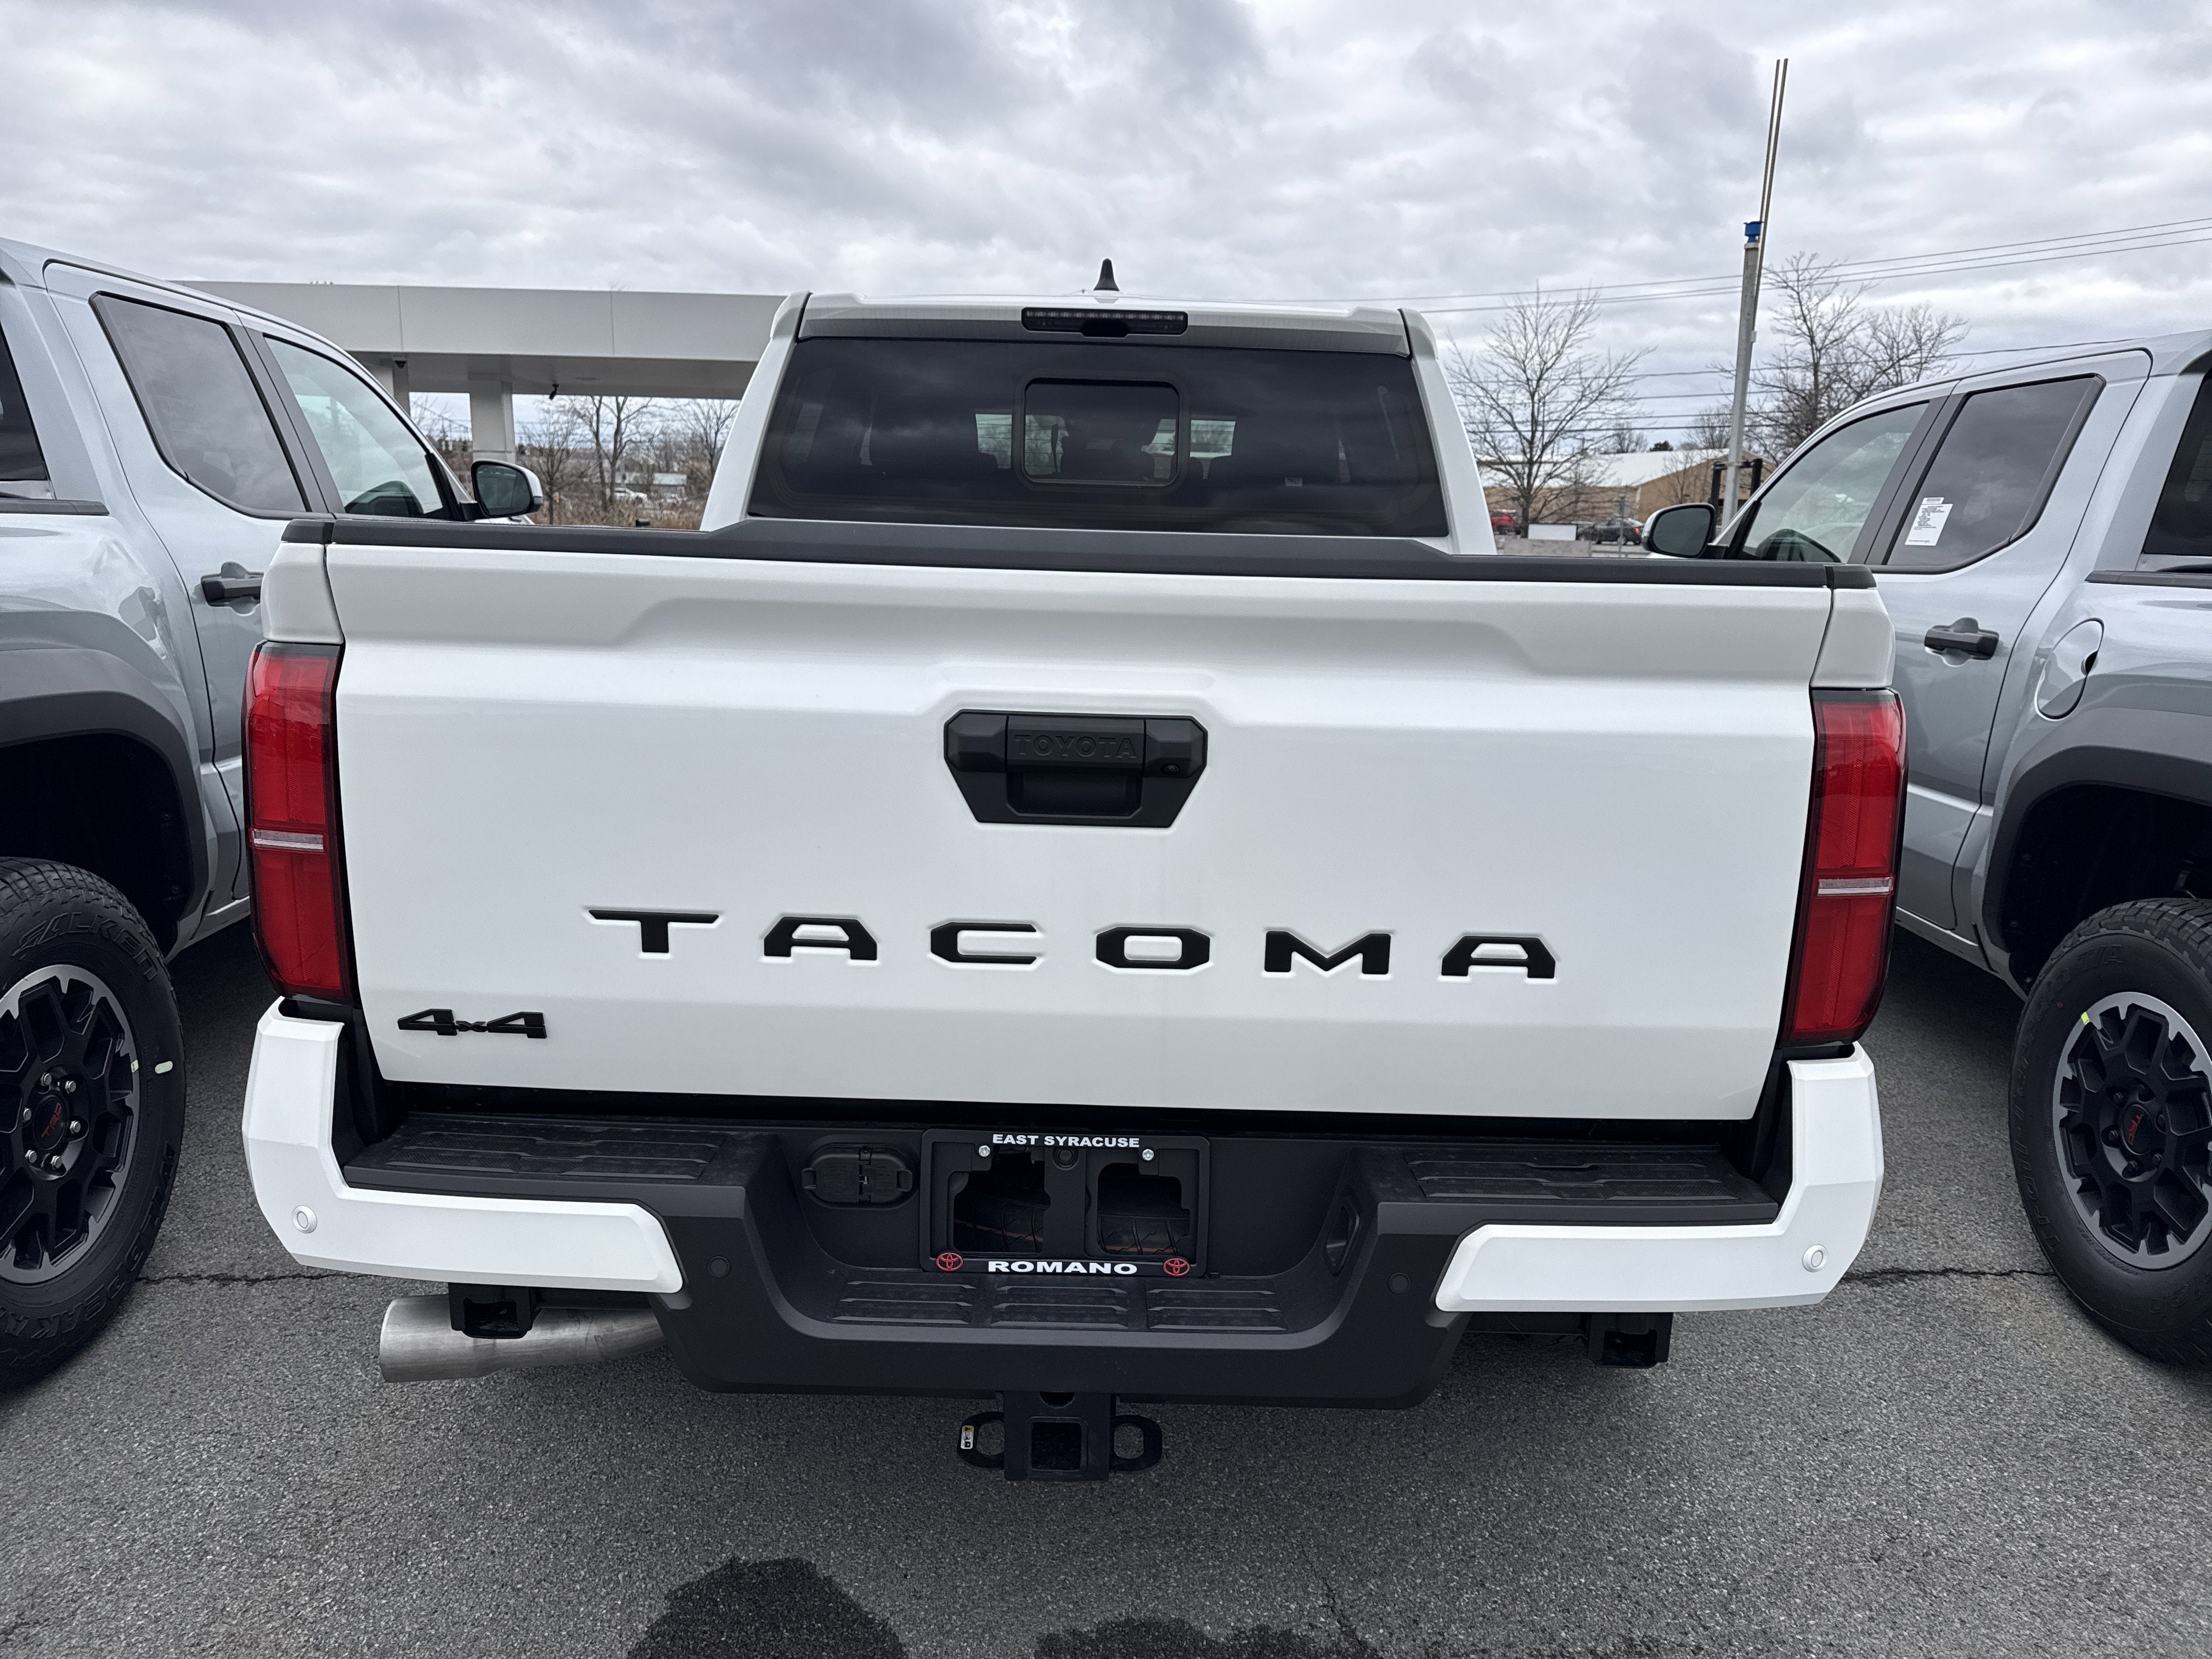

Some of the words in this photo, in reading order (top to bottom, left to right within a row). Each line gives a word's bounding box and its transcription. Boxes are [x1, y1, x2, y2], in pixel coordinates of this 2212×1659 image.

[1013, 733, 1138, 759] TOYOTA
[11, 912, 159, 981] FALKEN
[588, 909, 1557, 980] TACOMA
[397, 1008, 548, 1039] 4x4
[41, 1102, 62, 1138] TRD
[992, 1133, 1039, 1145] EAST
[1043, 1136, 1140, 1148] SYRACUSE
[988, 1261, 1137, 1275] ROMANO
